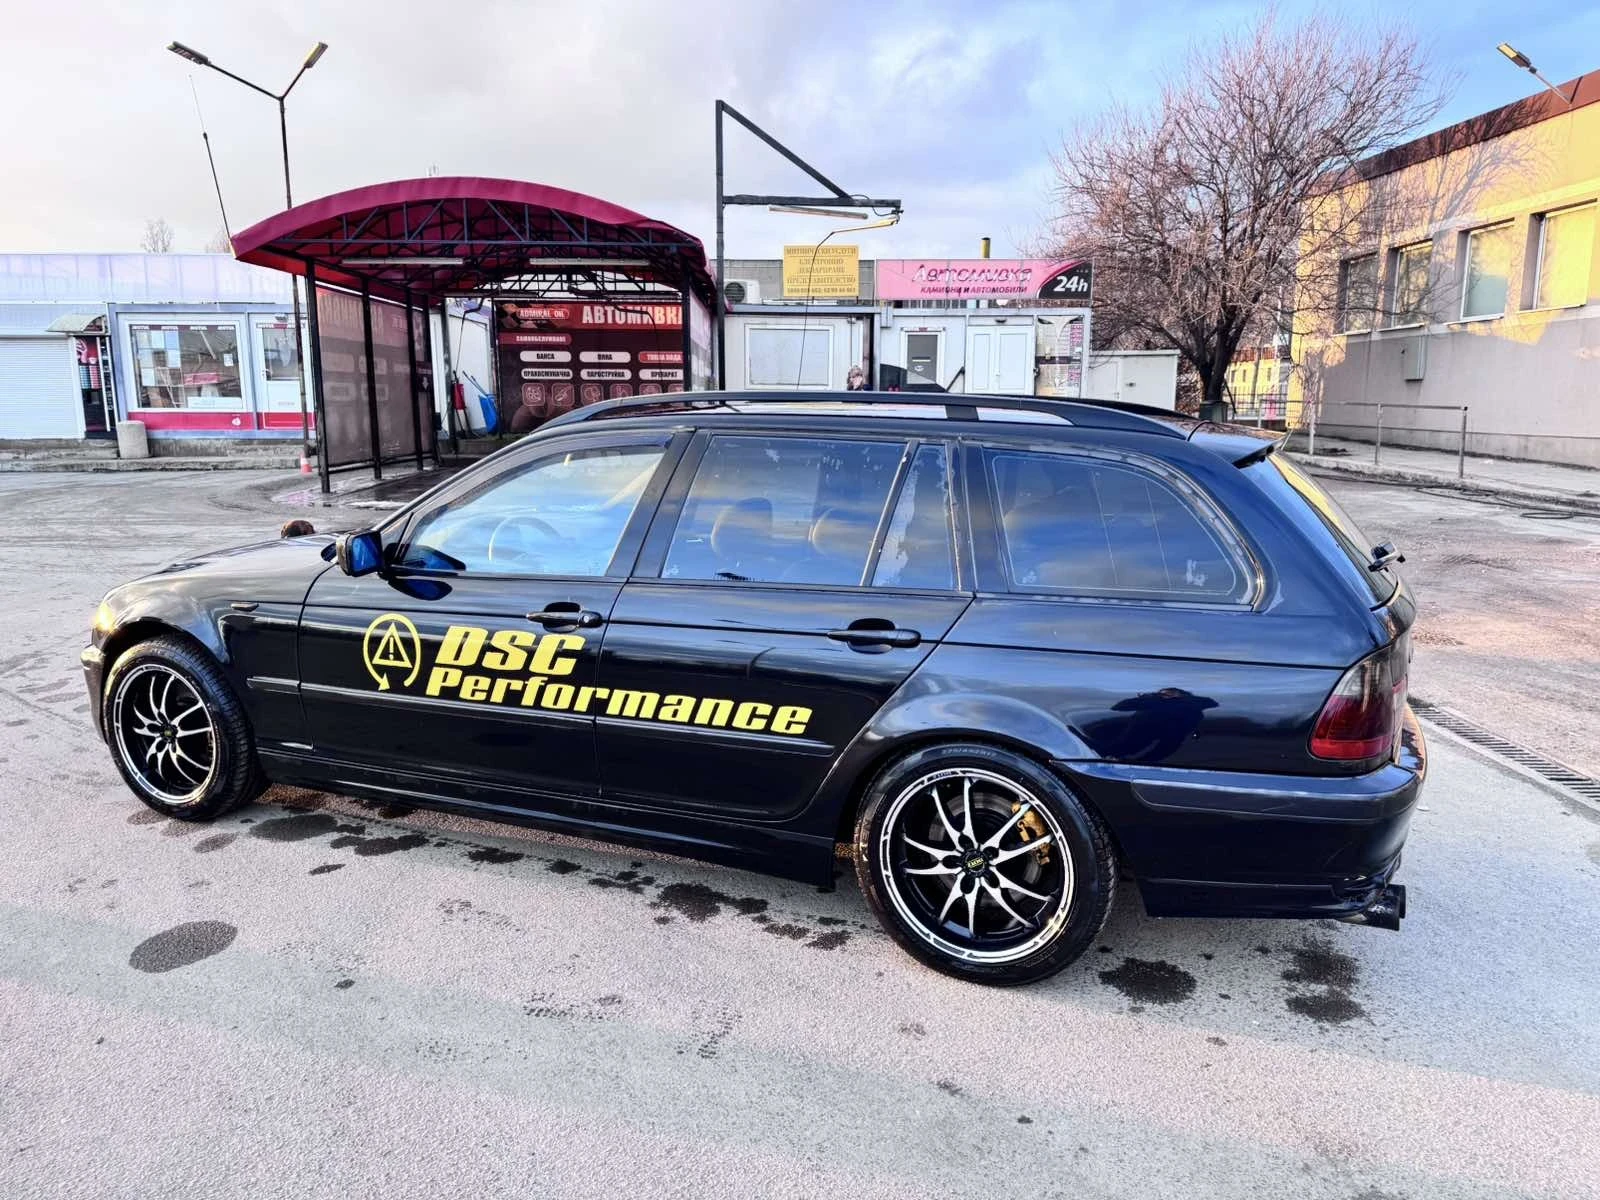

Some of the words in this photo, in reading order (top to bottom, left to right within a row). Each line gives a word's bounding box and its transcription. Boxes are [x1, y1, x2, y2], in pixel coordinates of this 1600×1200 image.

[970, 286, 1028, 294] АВТОМОБИЛИ
[1053, 275, 1089, 292] 24h
[520, 308, 552, 318] ADMIRAL
[554, 309, 565, 318] OIL
[435, 625, 586, 676] DSC
[425, 666, 812, 734] Performance
